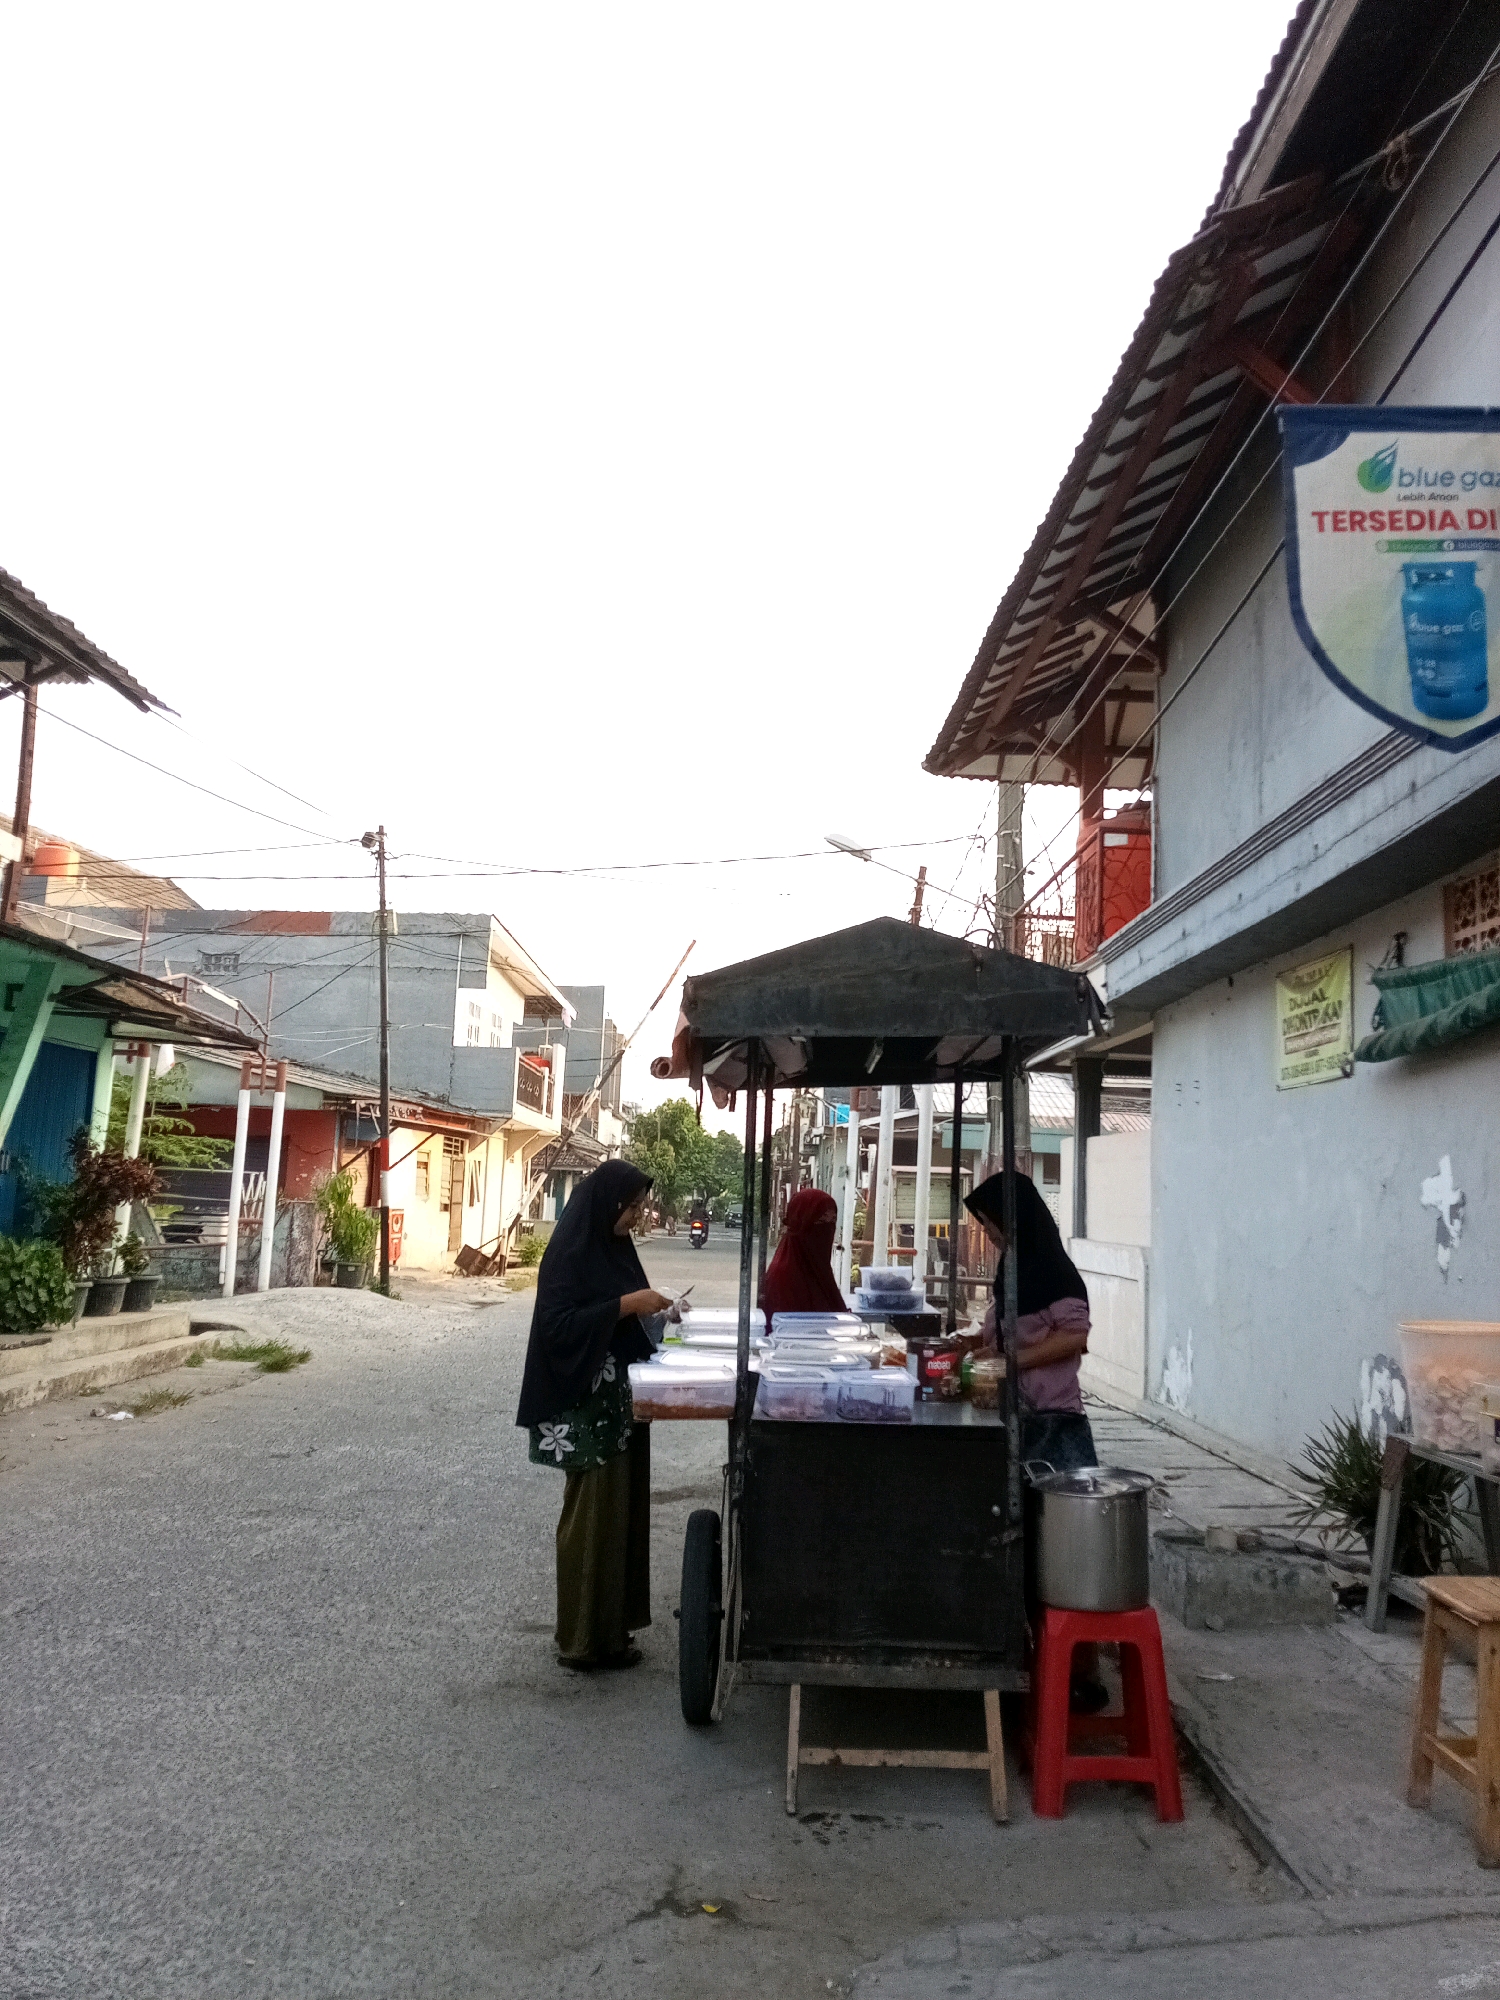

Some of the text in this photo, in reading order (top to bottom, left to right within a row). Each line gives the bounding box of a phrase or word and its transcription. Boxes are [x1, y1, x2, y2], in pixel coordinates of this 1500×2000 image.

[1398, 467, 1456, 487] blue
[1397, 492, 1459, 502] Lebih Aman
[1311, 508, 1498, 533] TERSEDIA DI
